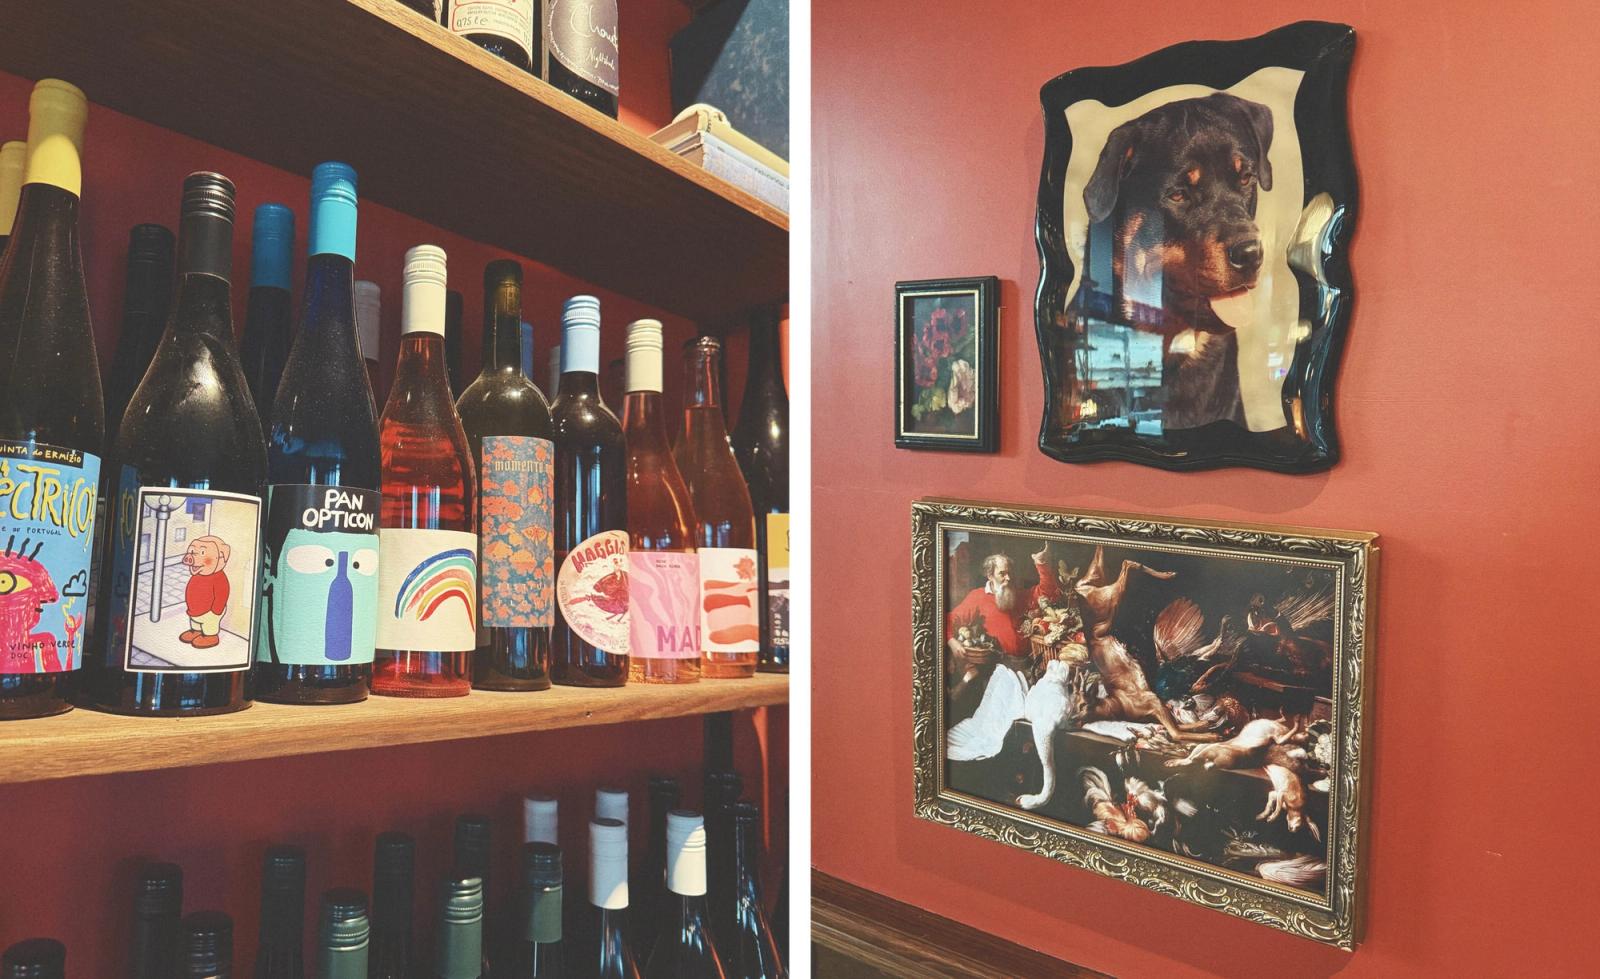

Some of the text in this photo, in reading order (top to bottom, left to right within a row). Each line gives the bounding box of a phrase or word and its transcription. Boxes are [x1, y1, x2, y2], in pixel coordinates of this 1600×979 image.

[324, 488, 364, 511] PAN
[302, 507, 374, 531] OPTICON
[26, 526, 62, 536] PORTUGAL
[10, 641, 45, 651] VINHO
[11, 651, 29, 660] DOC
